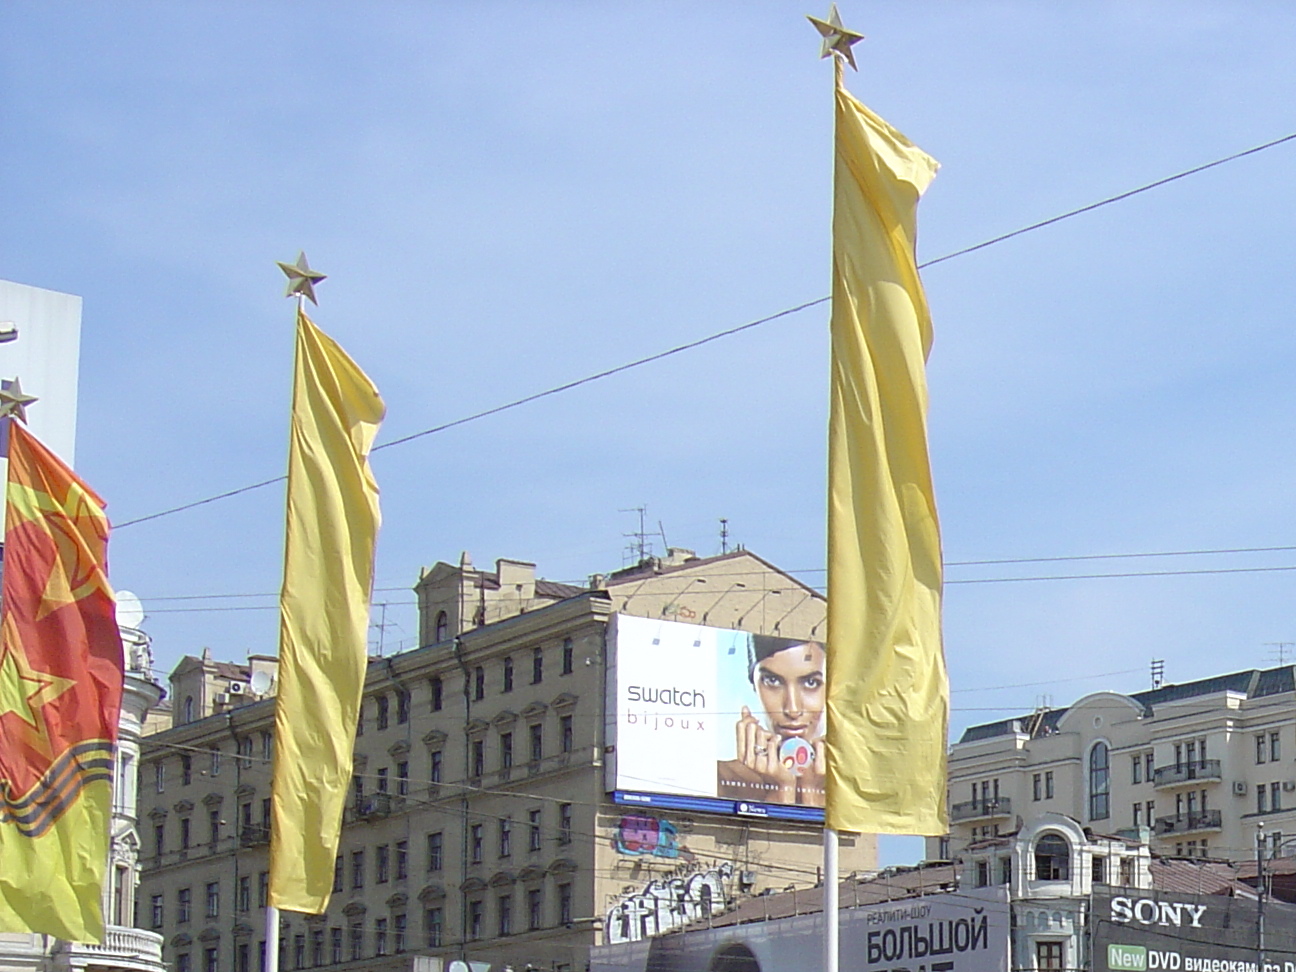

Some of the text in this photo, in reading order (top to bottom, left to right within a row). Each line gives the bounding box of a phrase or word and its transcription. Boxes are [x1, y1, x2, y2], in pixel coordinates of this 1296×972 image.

[627, 684, 705, 709] swatch
[627, 708, 705, 731] bijoux
[867, 905, 932, 926] РЕАЛИТИ-ШОУ
[1110, 897, 1207, 928] SONY
[867, 907, 988, 965] БОЛЬШОЙ
[1111, 948, 1145, 968] New
[1148, 950, 1181, 970] DVD
